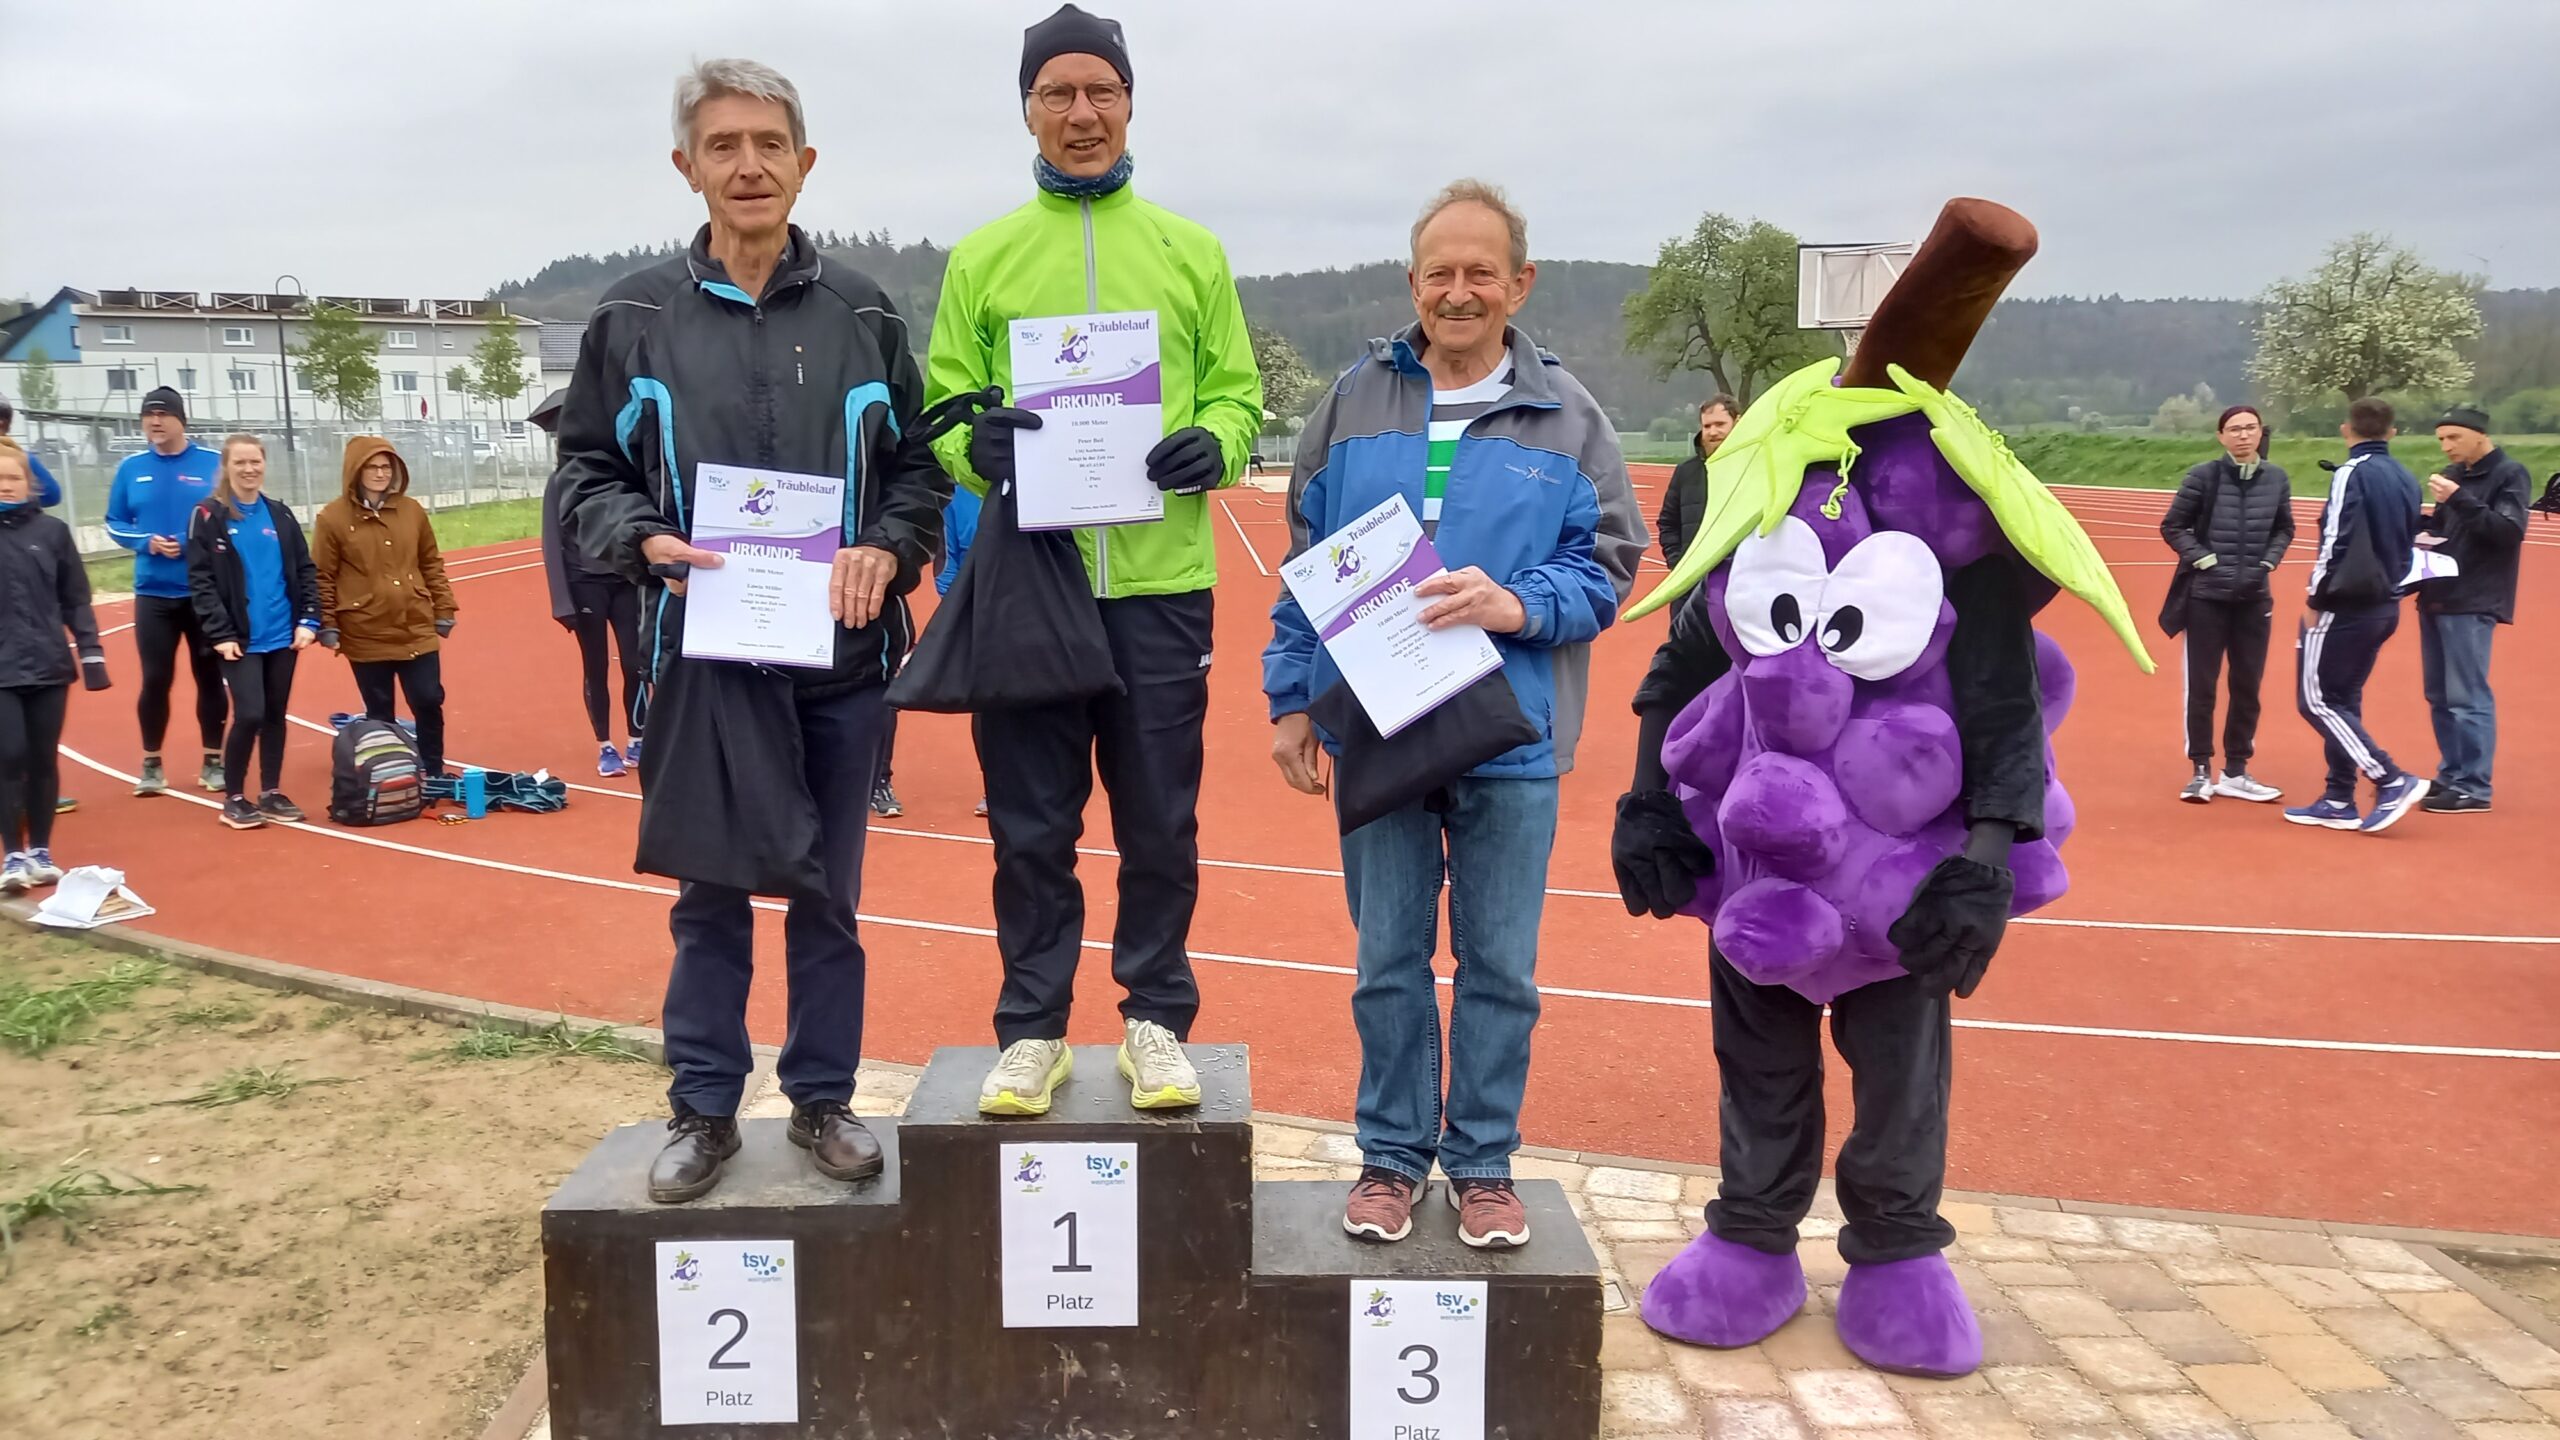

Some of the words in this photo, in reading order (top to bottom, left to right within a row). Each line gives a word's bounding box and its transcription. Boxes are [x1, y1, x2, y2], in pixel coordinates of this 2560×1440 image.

[1088, 318, 1150, 333] Träublelauf
[1050, 392, 1124, 410] URKUNDE
[709, 475, 723, 484] tsv
[776, 479, 836, 495] Träublelauf
[1347, 502, 1402, 542] Träublelauf
[729, 541, 802, 560] URKUNDE
[1294, 567, 1307, 578] tsv
[1349, 577, 1413, 623] URKUNDE
[1086, 1154, 1113, 1170] tsv
[1052, 1212, 1092, 1272] 1
[742, 1252, 769, 1267] tsv
[1047, 1293, 1094, 1310] Platz
[1436, 1291, 1463, 1307] tsv
[707, 1308, 751, 1370] 2
[1396, 1344, 1440, 1405] 3
[706, 1390, 753, 1406] Platz
[1394, 1424, 1440, 1440] Platz
